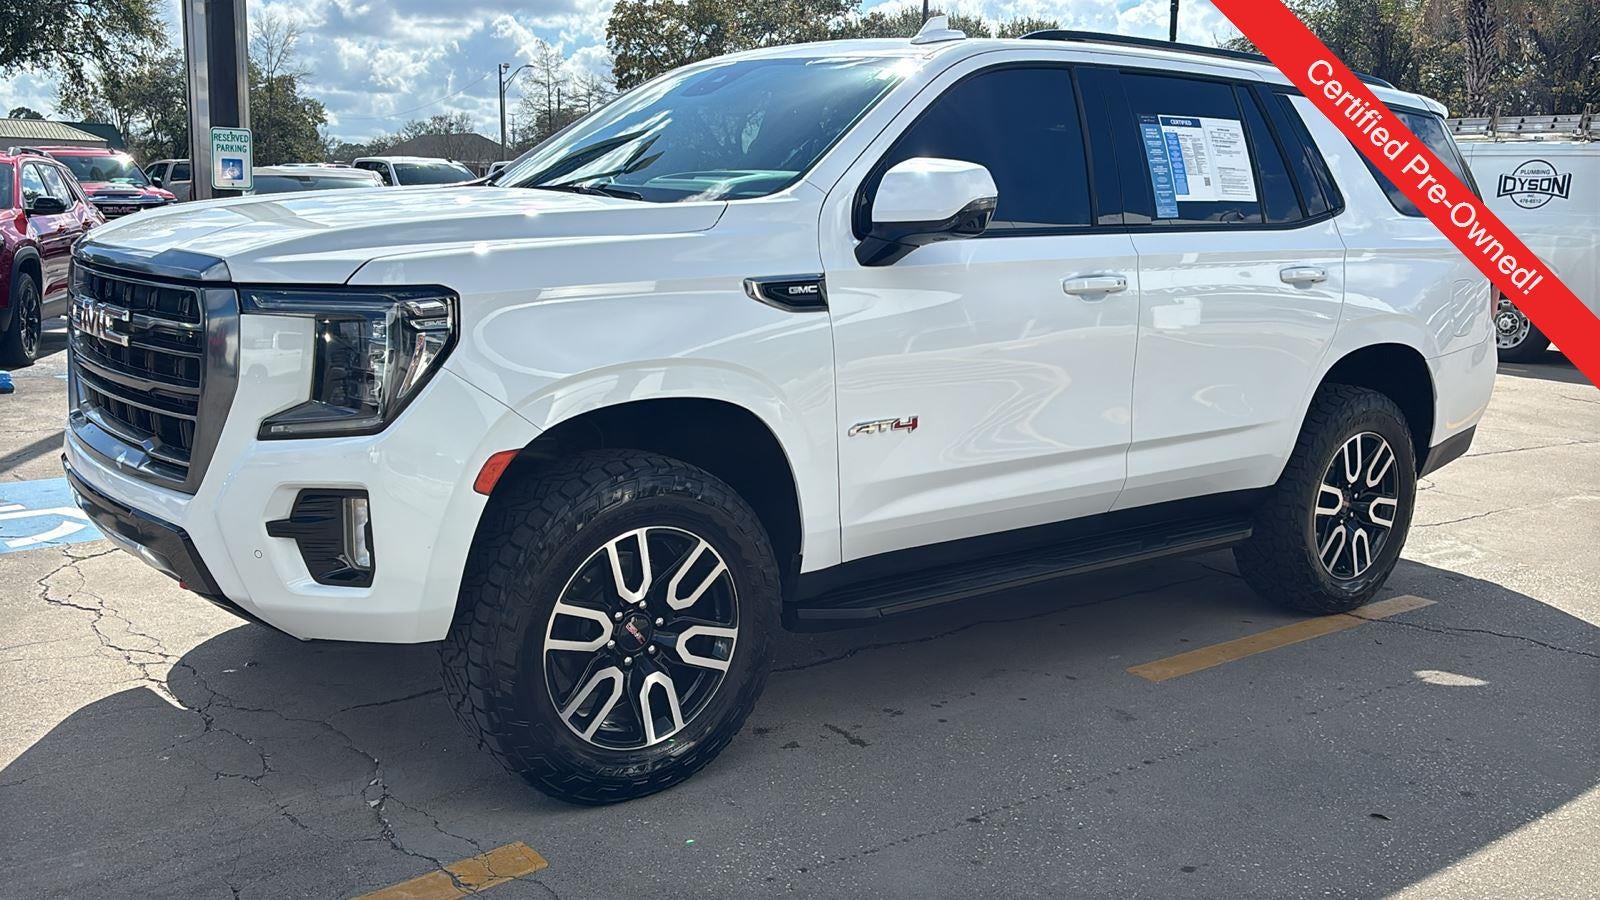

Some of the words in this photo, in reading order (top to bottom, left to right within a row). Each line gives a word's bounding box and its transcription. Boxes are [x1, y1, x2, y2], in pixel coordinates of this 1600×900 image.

[1169, 118, 1193, 126] CERTIFIED
[213, 133, 249, 143] RESERVED
[216, 144, 248, 154] PARKING
[1502, 174, 1567, 195] DYSON
[102, 206, 137, 214] GMC
[788, 284, 818, 294] GMC
[71, 294, 130, 347] GMC
[424, 319, 447, 327] GMC
[848, 415, 919, 437] AT4
